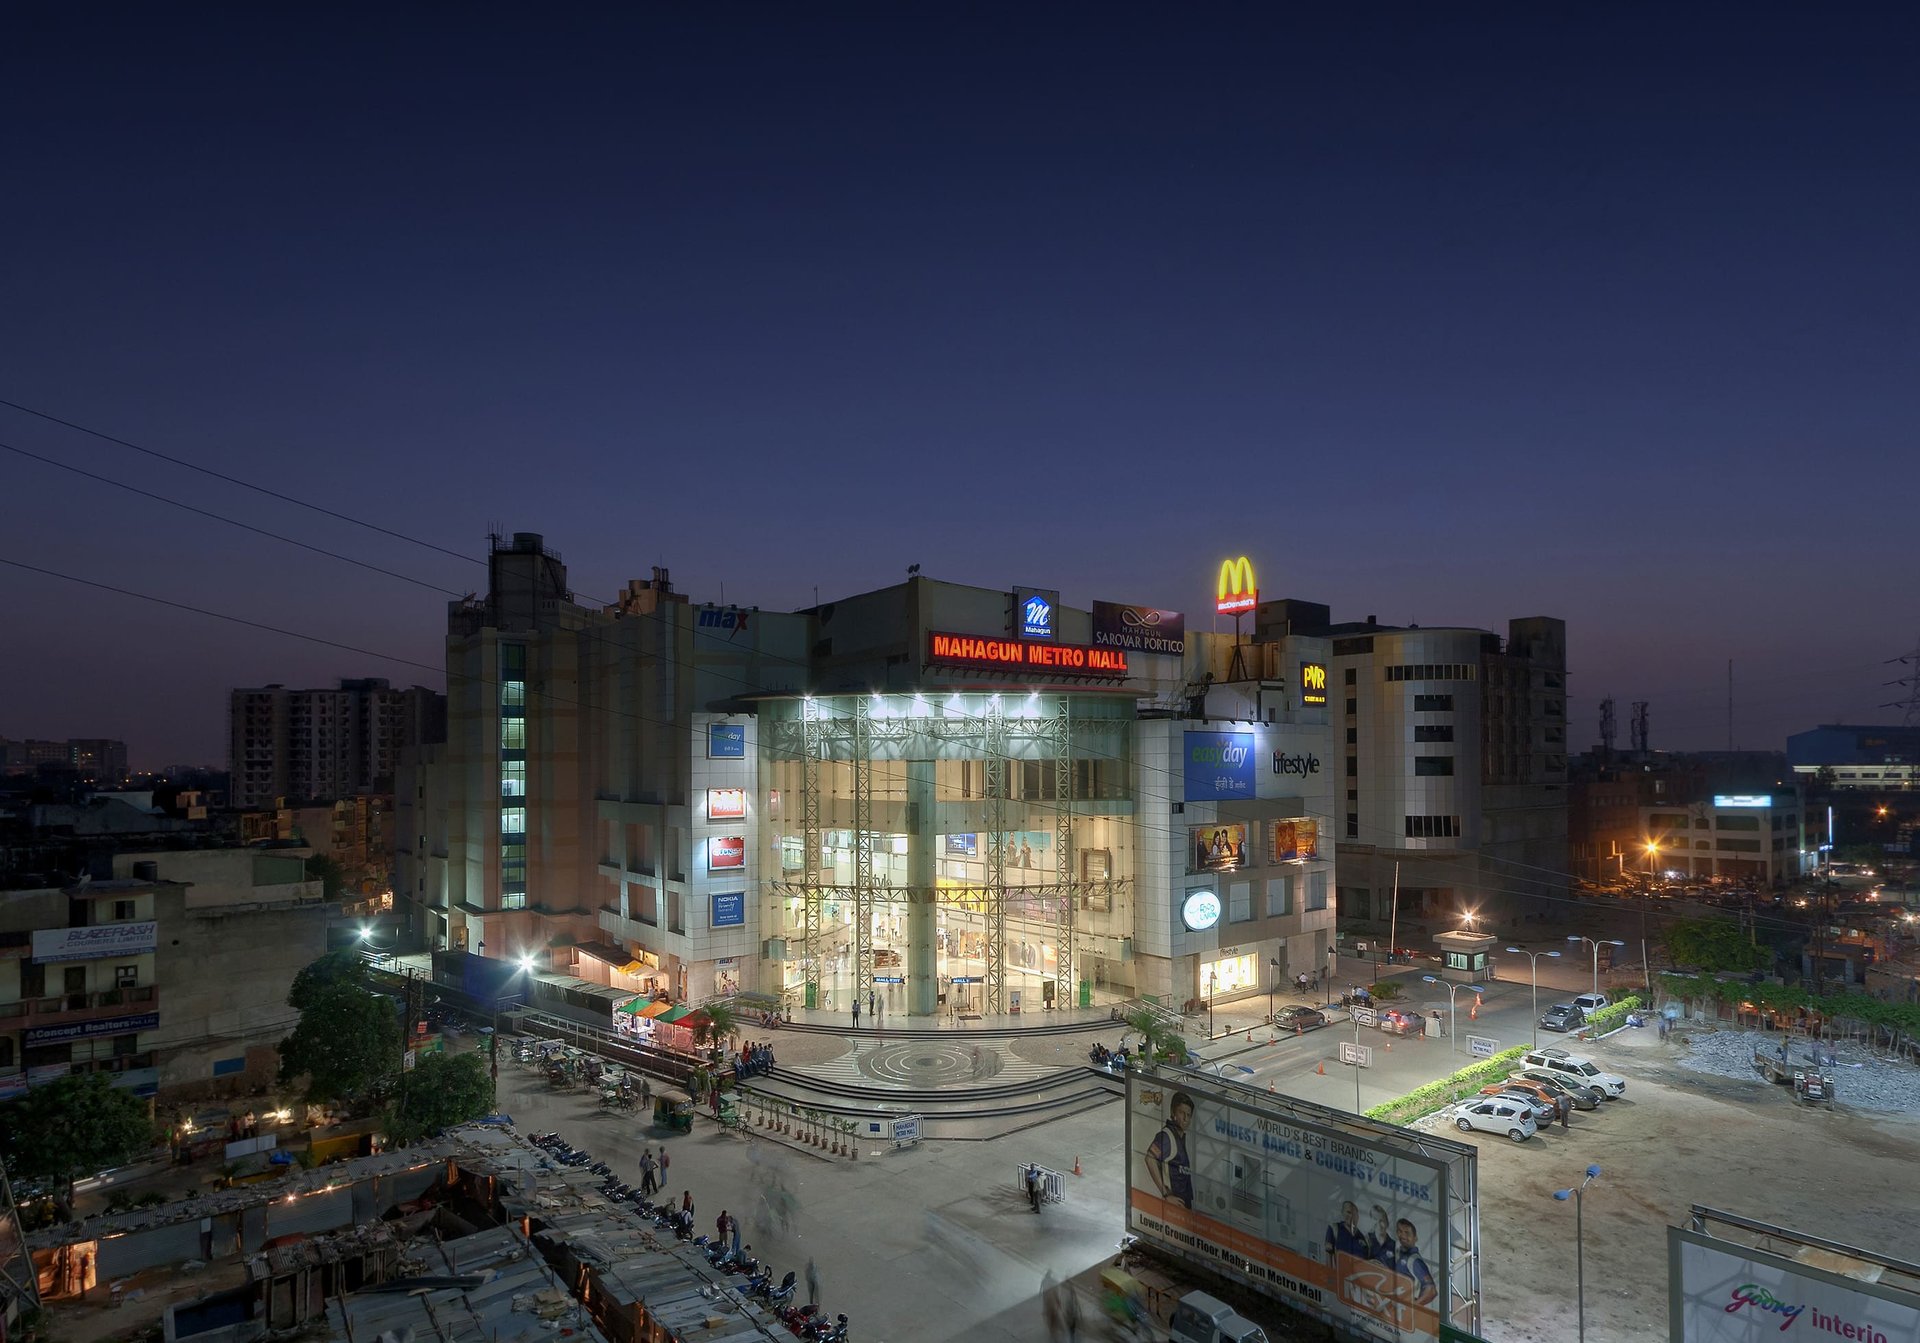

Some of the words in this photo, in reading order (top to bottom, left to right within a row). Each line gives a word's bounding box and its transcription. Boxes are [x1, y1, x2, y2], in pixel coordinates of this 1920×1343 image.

[1218, 598, 1254, 610] McDonald's
[699, 609, 749, 642] max
[1025, 626, 1051, 635] Mahagun
[1122, 626, 1161, 638] MAHAGUN
[934, 636, 1023, 663] MAHAGUN
[1029, 645, 1084, 668] METRO
[1088, 650, 1127, 670] MALL
[1096, 631, 1142, 649] SAROVAR
[1144, 637, 1184, 653] PORTICO
[1304, 665, 1325, 690] PVR
[1192, 741, 1249, 769] easyday
[1272, 748, 1320, 779] lifestyle
[66, 923, 155, 941] BLAZEFLASH
[117, 933, 153, 943] LIMITED
[36, 1026, 82, 1039] Concept
[85, 1021, 130, 1032] Realtors
[1257, 1118, 1300, 1142] WORLD'S
[1302, 1131, 1327, 1149] BEST
[1330, 1140, 1378, 1167] BRANDS,
[1215, 1118, 1258, 1145] WIDEST
[1262, 1132, 1301, 1159] RANGE
[1304, 1149, 1313, 1161] &
[1315, 1150, 1375, 1183] COOLEST
[1379, 1170, 1433, 1203] OFFERS.
[1139, 1213, 1164, 1234] Lower
[1164, 1225, 1195, 1248] Ground
[1196, 1238, 1221, 1259] Floor,
[1221, 1250, 1266, 1279] Mahagun
[1267, 1269, 1298, 1293] Metro
[1299, 1284, 1322, 1303] Mall
[1343, 1277, 1407, 1323] NEXT
[1725, 1283, 1806, 1332] Godrej
[1811, 1307, 1888, 1343] interio
